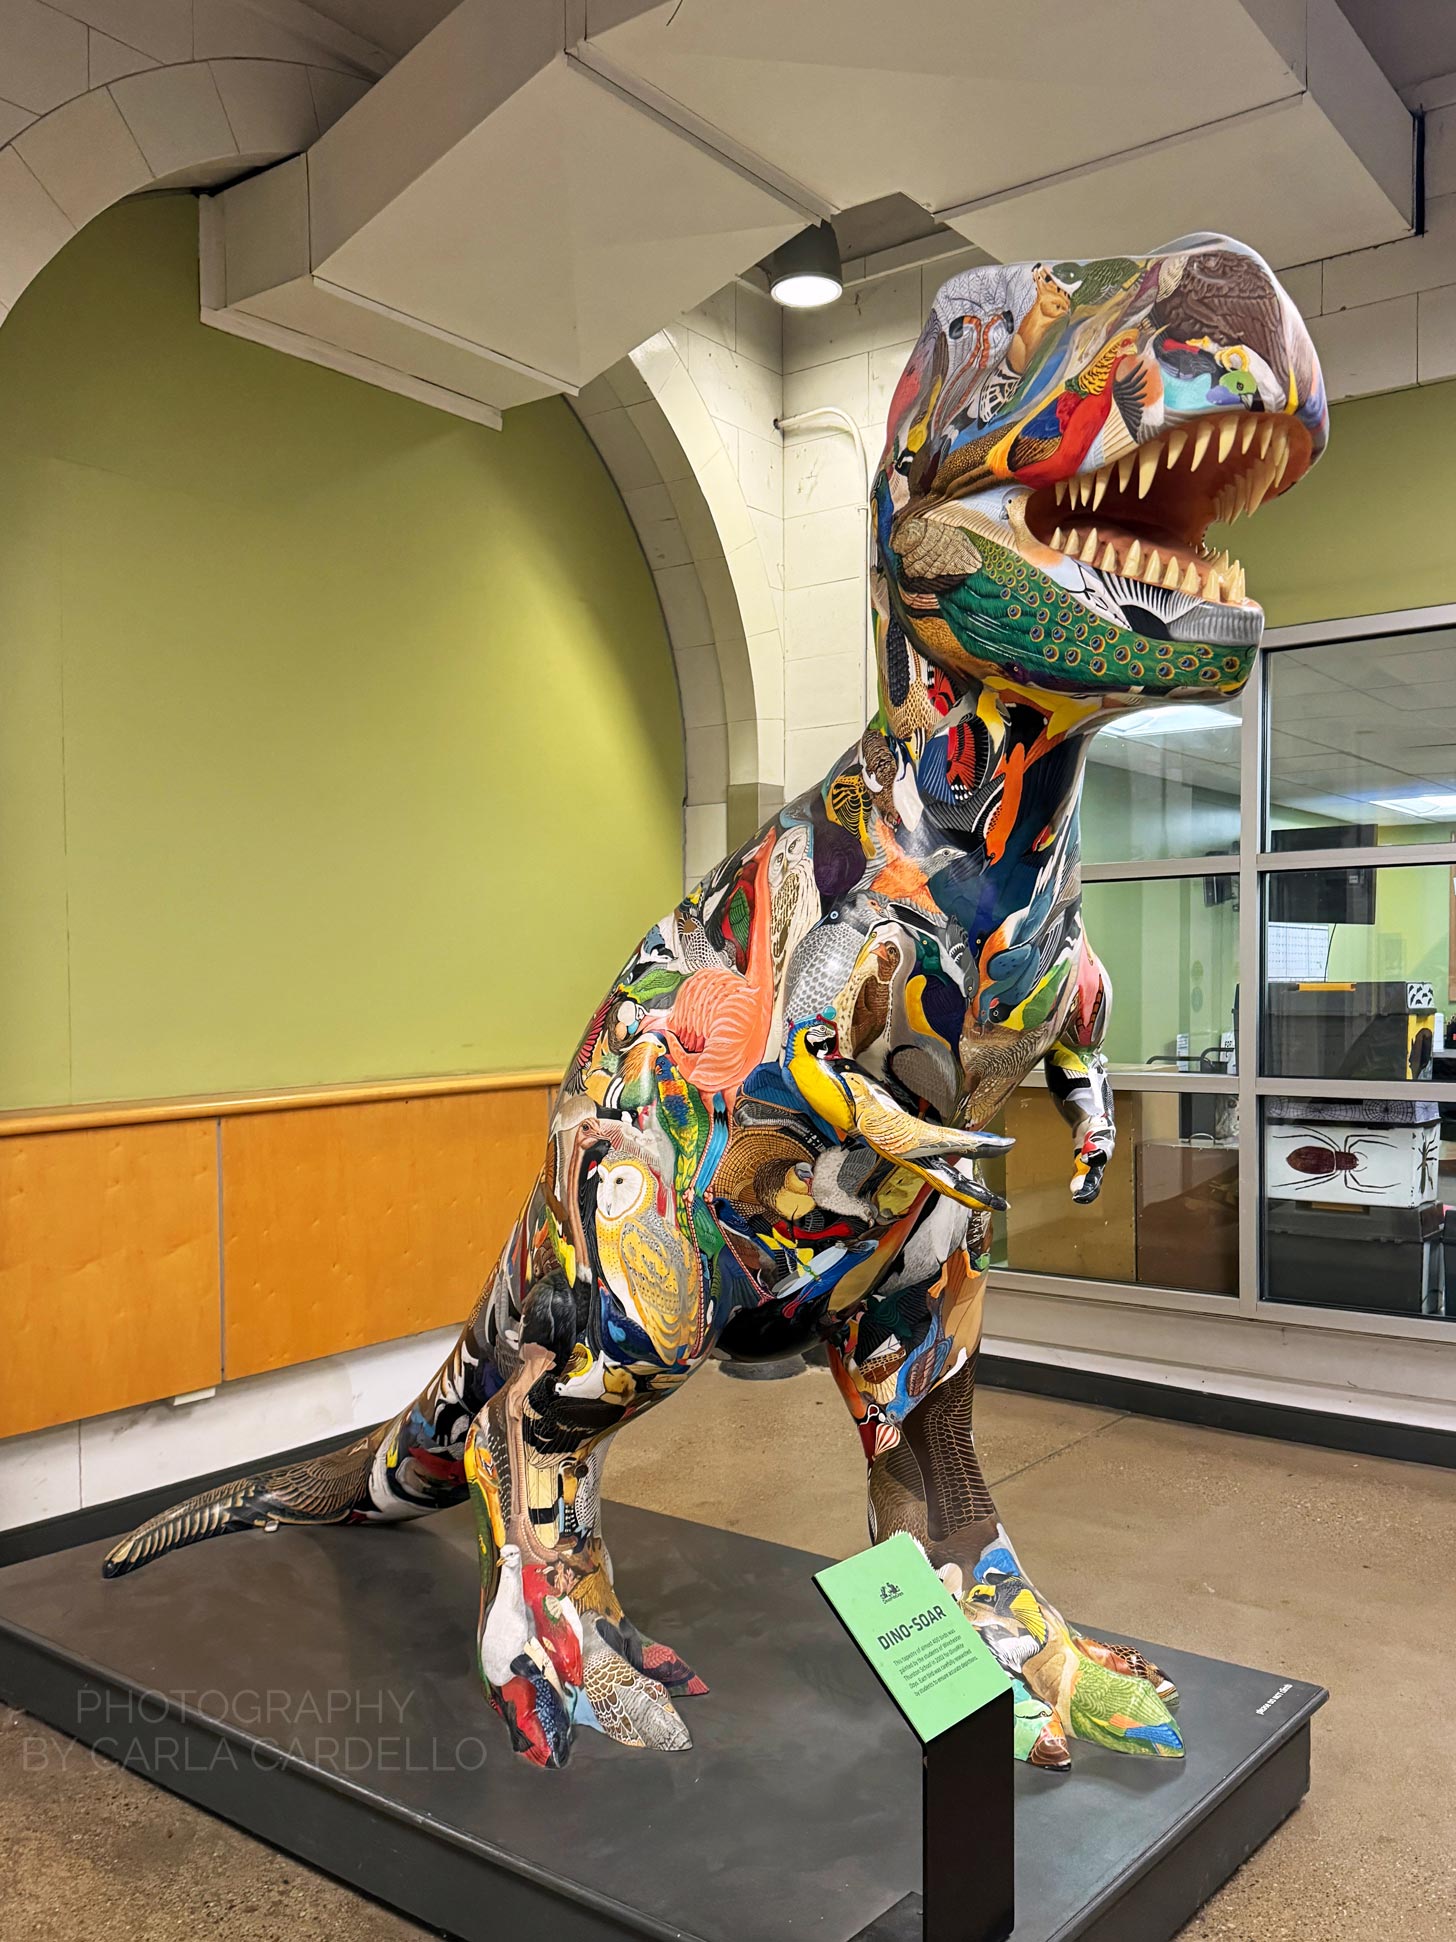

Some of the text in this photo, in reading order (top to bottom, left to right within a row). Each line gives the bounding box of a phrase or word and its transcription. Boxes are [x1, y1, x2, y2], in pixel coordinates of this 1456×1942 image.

[878, 1606, 946, 1650] DINO-SOAR
[899, 1663, 913, 1675] painted
[924, 1648, 939, 1659] students
[942, 1635, 961, 1648] Winchester
[901, 1651, 917, 1662] tapestry
[921, 1641, 933, 1651] almost
[941, 1660, 955, 1670] carefully
[954, 1649, 972, 1661] researched
[919, 1662, 932, 1672] School
[919, 1682, 934, 1694] students
